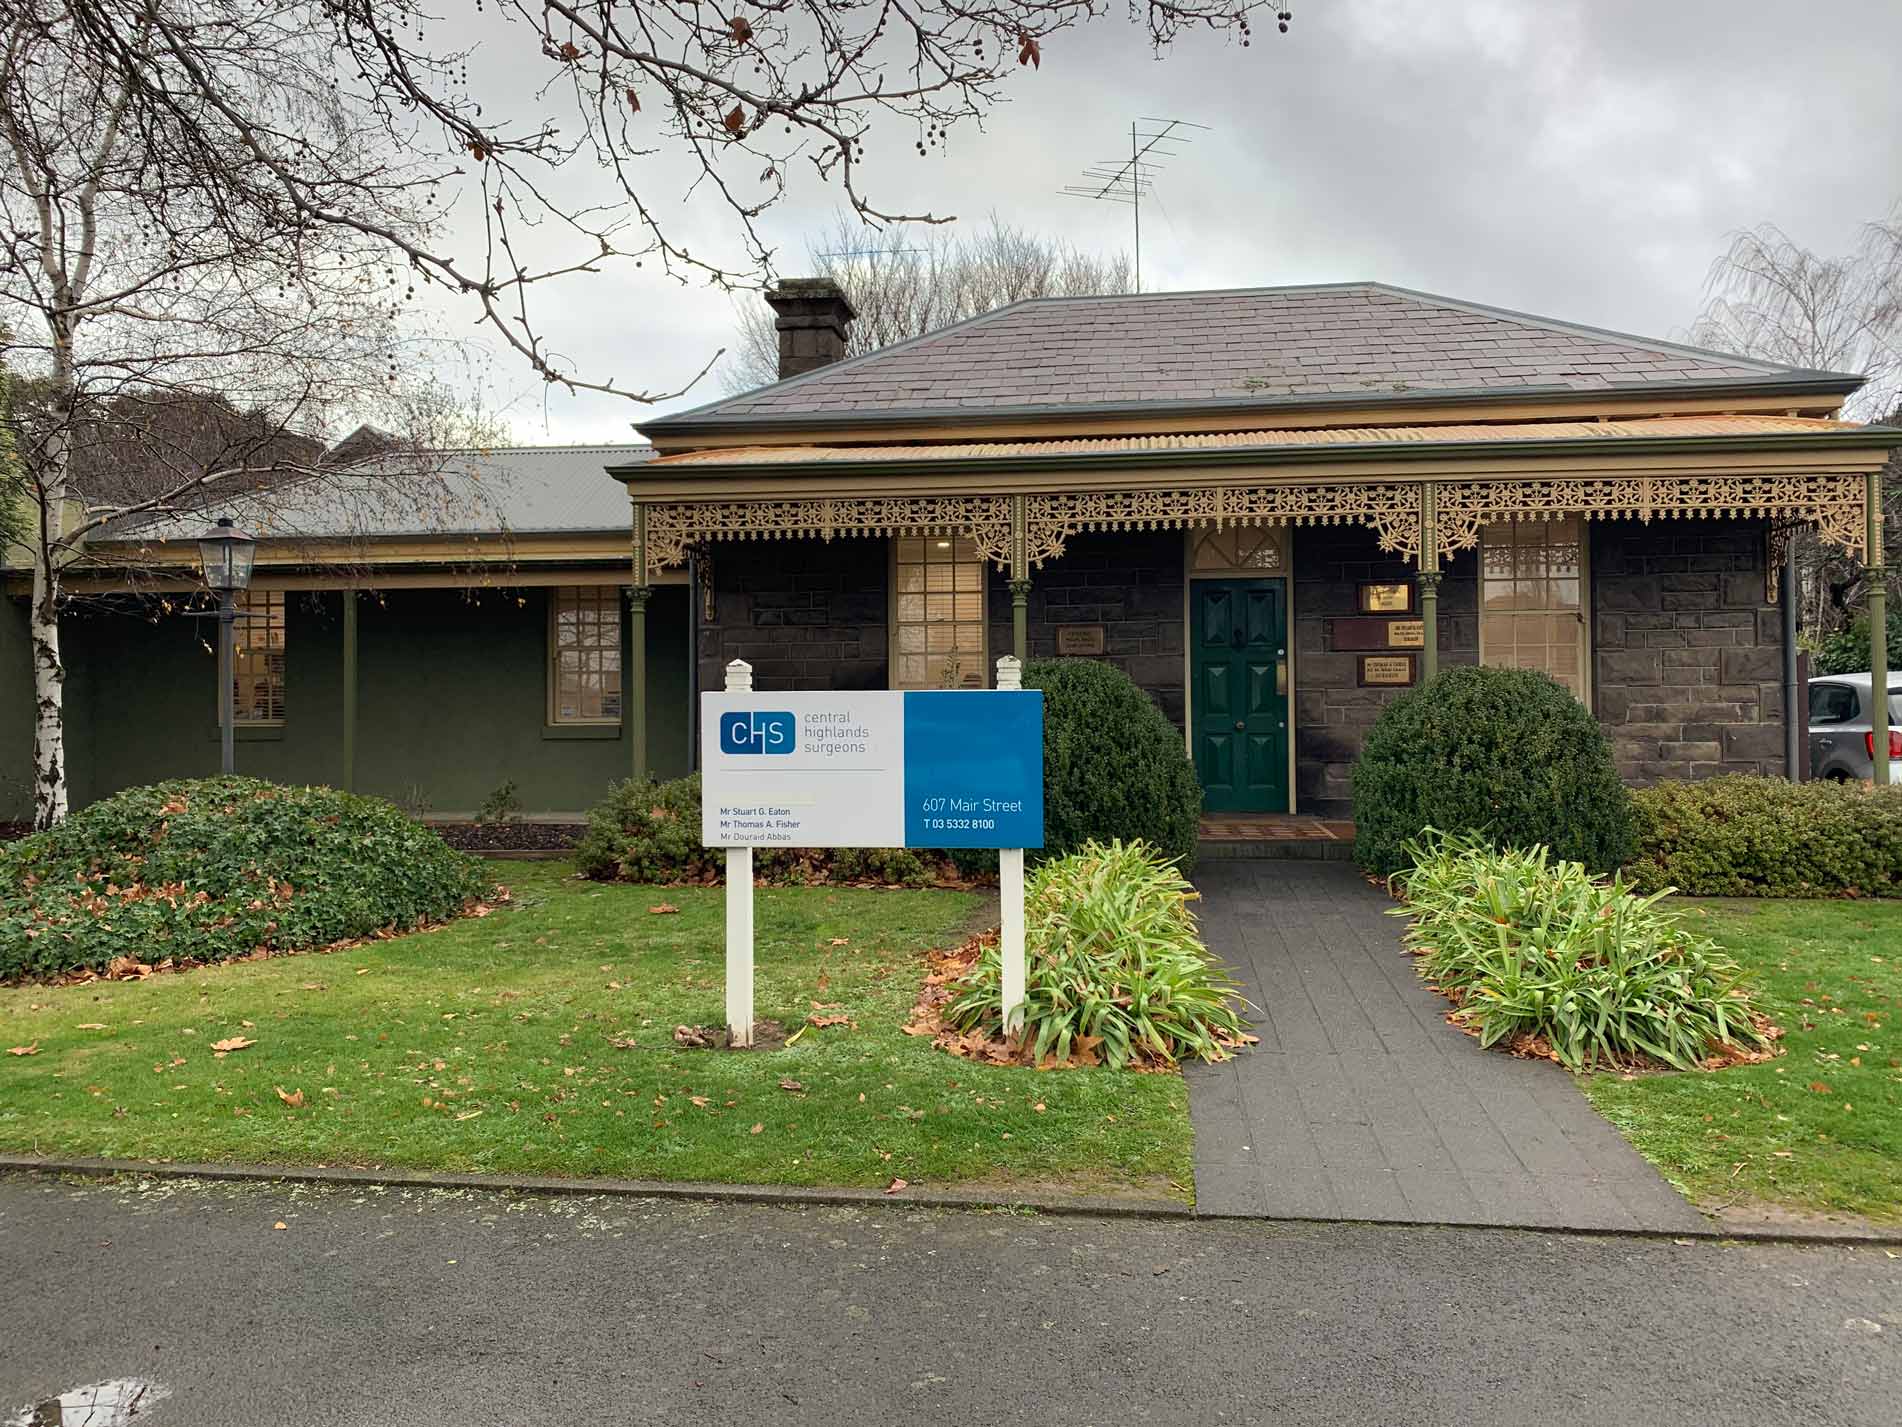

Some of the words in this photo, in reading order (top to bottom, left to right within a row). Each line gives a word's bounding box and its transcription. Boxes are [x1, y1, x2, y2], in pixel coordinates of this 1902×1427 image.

[804, 712, 850, 723] central
[732, 713, 784, 753] CHS
[804, 726, 869, 741] highlands
[804, 742, 866, 756] surgeons
[922, 798, 946, 812] 607
[950, 798, 979, 812] Mair
[983, 798, 1022, 812] Street
[720, 808, 731, 816] Mr
[733, 808, 756, 816] Stuart
[758, 808, 767, 816] G.
[769, 808, 791, 816] Eaton
[720, 820, 731, 829] Mr
[733, 820, 764, 829] Thomas
[766, 820, 774, 829] A.
[776, 820, 800, 829] Fisher
[924, 819, 930, 829] T
[932, 819, 944, 829] 03
[946, 819, 970, 829] 5332
[972, 819, 994, 829] 8100
[720, 833, 731, 841] Mr
[733, 833, 765, 841] Douraid
[767, 833, 791, 841] Abbas
